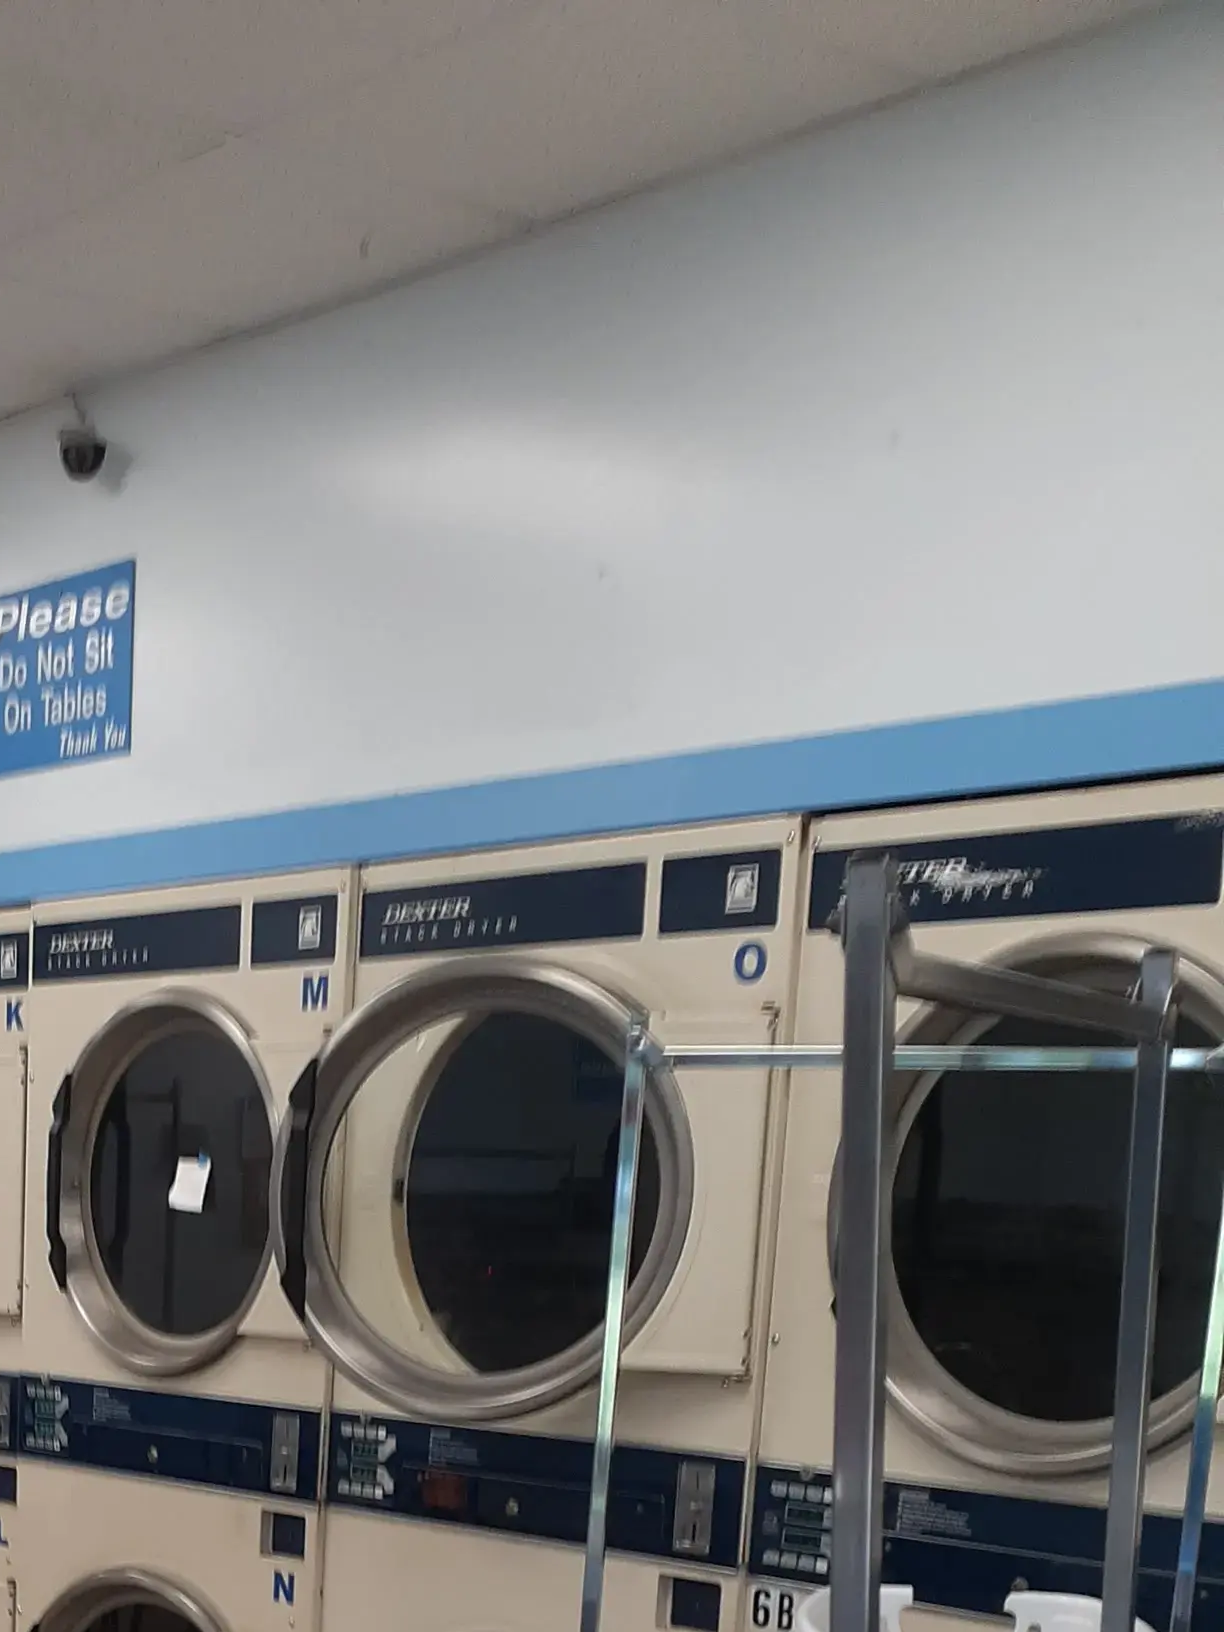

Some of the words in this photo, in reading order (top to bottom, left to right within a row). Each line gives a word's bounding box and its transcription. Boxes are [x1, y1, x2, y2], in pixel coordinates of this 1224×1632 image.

[0, 653, 27, 692] Do
[37, 639, 74, 684] Not
[85, 629, 114, 675] Sit
[4, 693, 31, 734] On
[42, 680, 107, 727] Tables
[60, 720, 98, 758] Thank
[105, 717, 127, 750] You
[382, 896, 471, 925] DEXTER
[50, 929, 114, 954] DEXTER
[302, 976, 329, 1012] M
[6, 998, 24, 1031] K
[273, 1572, 295, 1605] N
